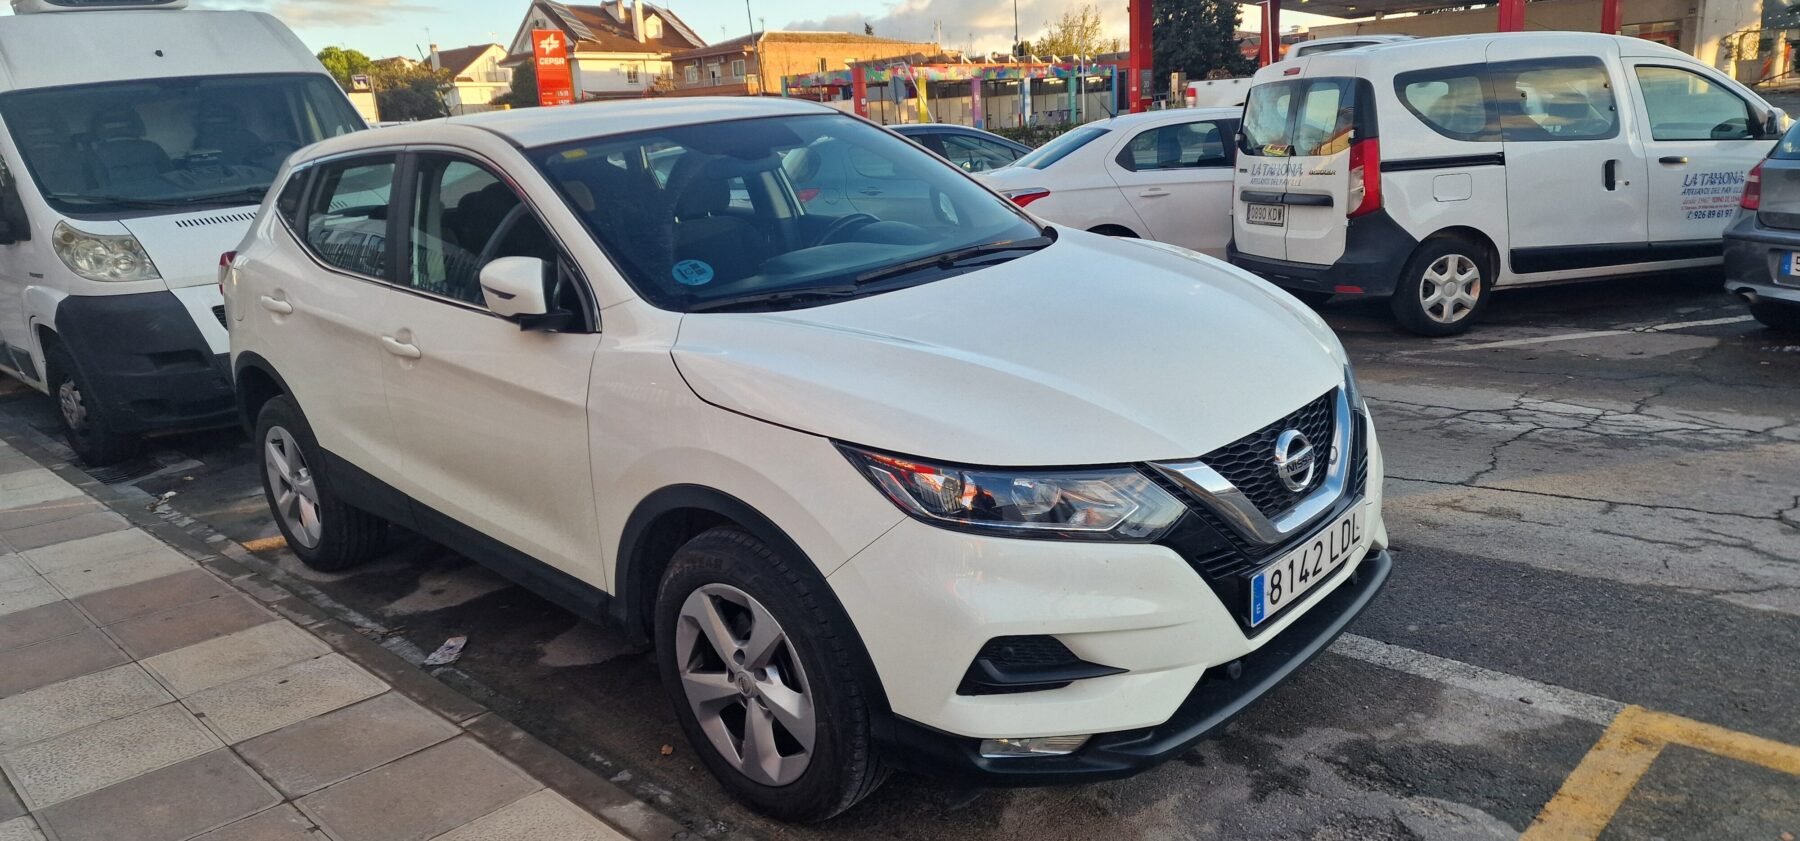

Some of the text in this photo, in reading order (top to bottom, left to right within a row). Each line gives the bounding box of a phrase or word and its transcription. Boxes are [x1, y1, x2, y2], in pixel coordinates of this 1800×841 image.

[539, 57, 565, 65] CEPSA
[1682, 170, 1745, 187] LA TAHONA
[1694, 211, 1706, 219] 926
[1707, 210, 1716, 218] 89
[1724, 209, 1733, 217] 97
[1269, 513, 1360, 605] 8142 LDL
